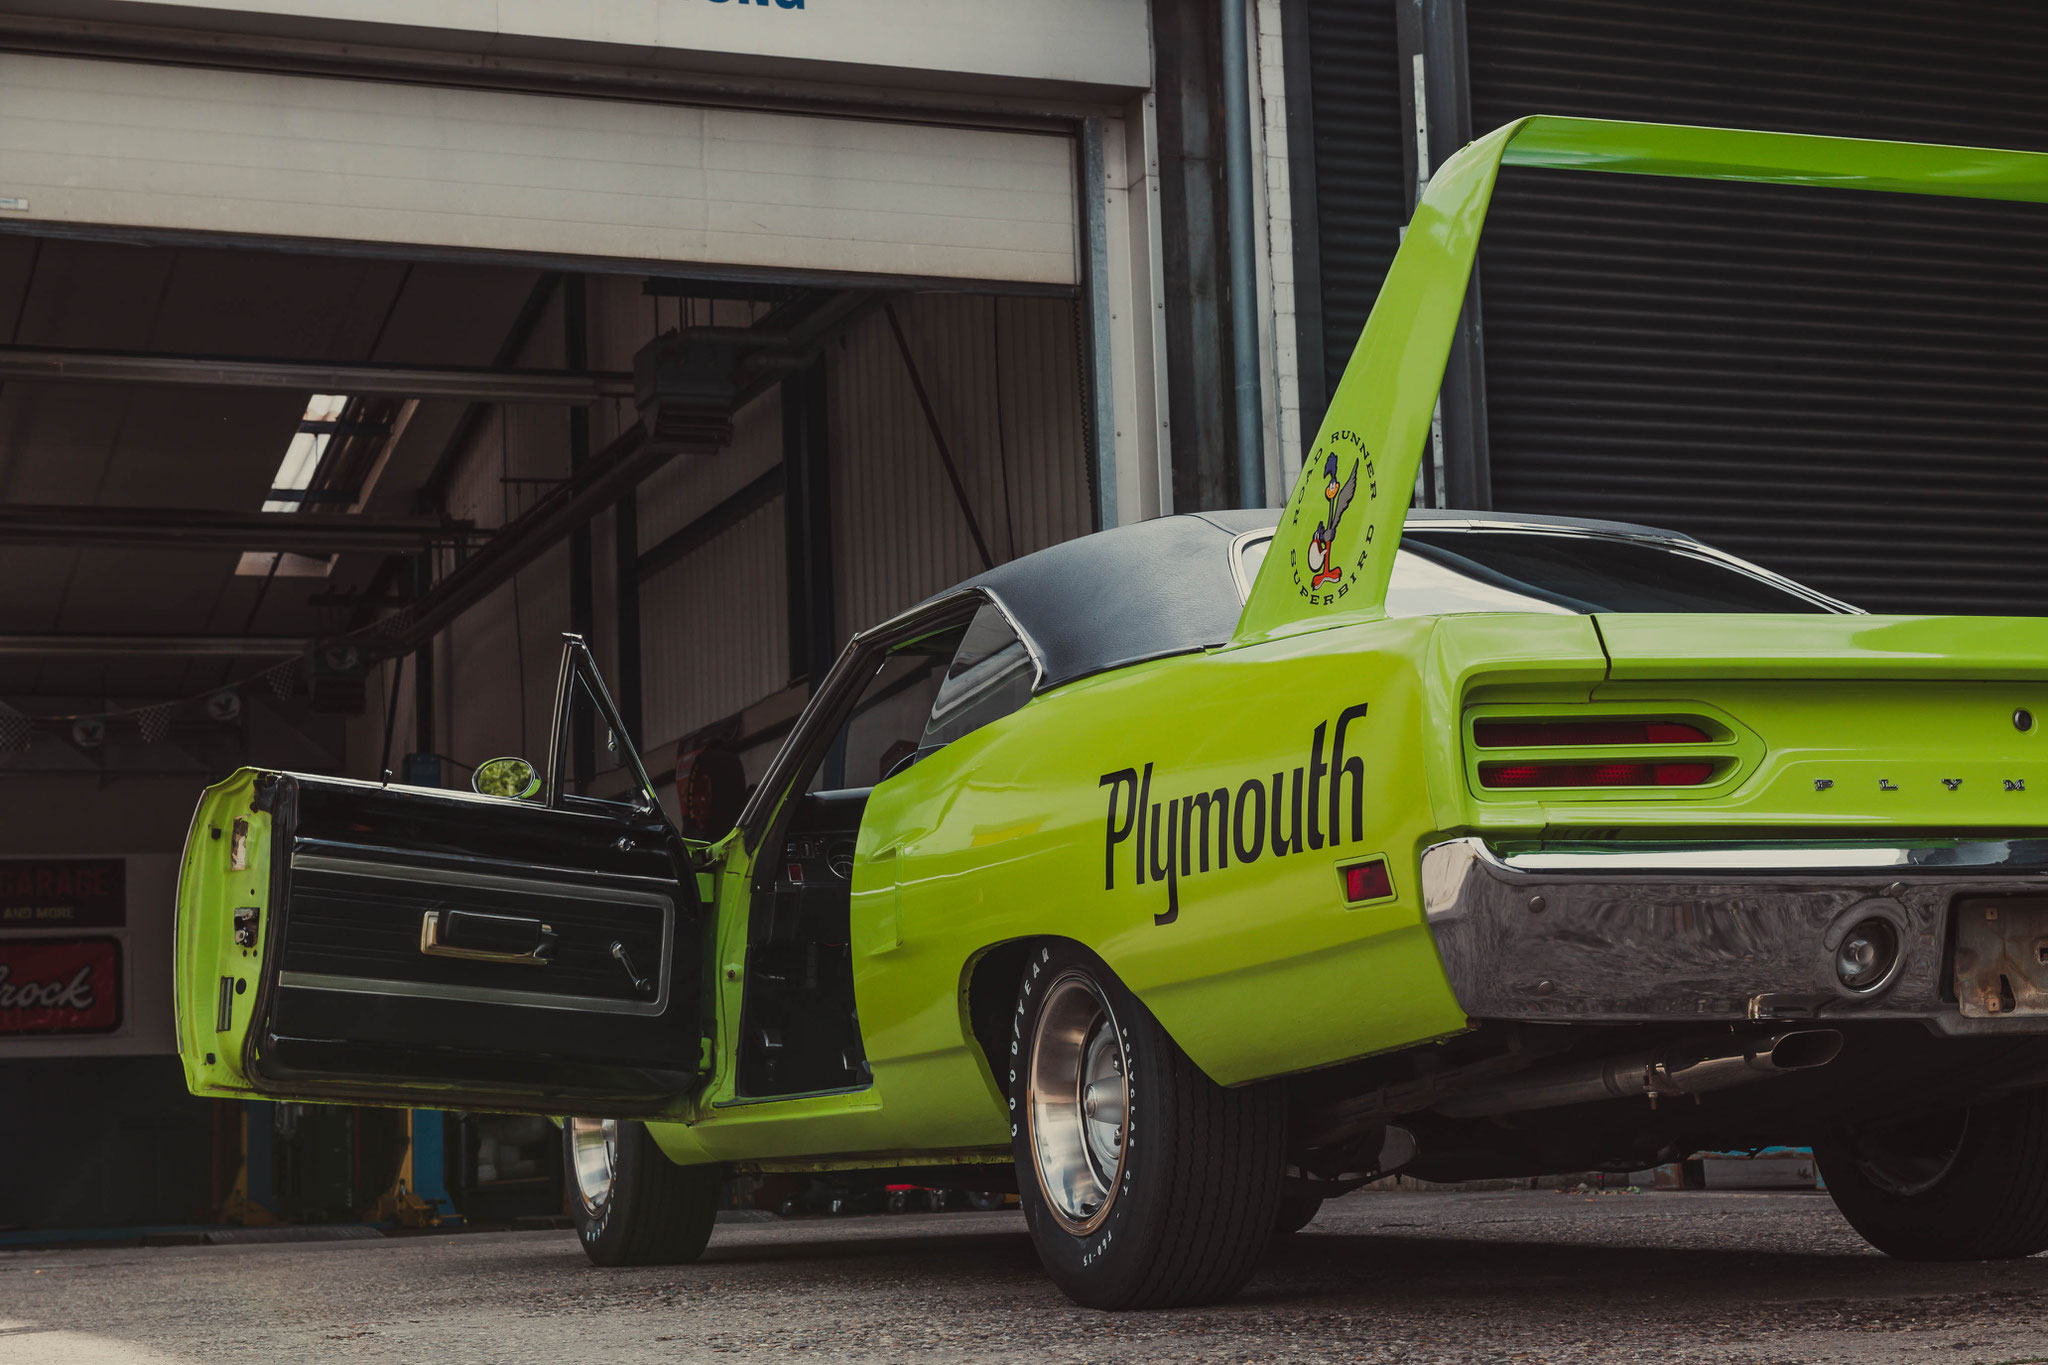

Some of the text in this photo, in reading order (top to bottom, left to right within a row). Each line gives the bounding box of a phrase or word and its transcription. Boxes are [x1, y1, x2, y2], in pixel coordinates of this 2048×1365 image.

[1292, 430, 1377, 526] ROAD RUNNER
[1290, 524, 1375, 606] SUPERBIRD
[1099, 703, 1368, 926] Plymouth
[3, 906, 74, 919] AND MORE
[1009, 947, 1050, 1138] GOODYEAR
[1122, 1027, 1137, 1147] POLYGLAS
[1083, 1230, 1112, 1267] F60-15
